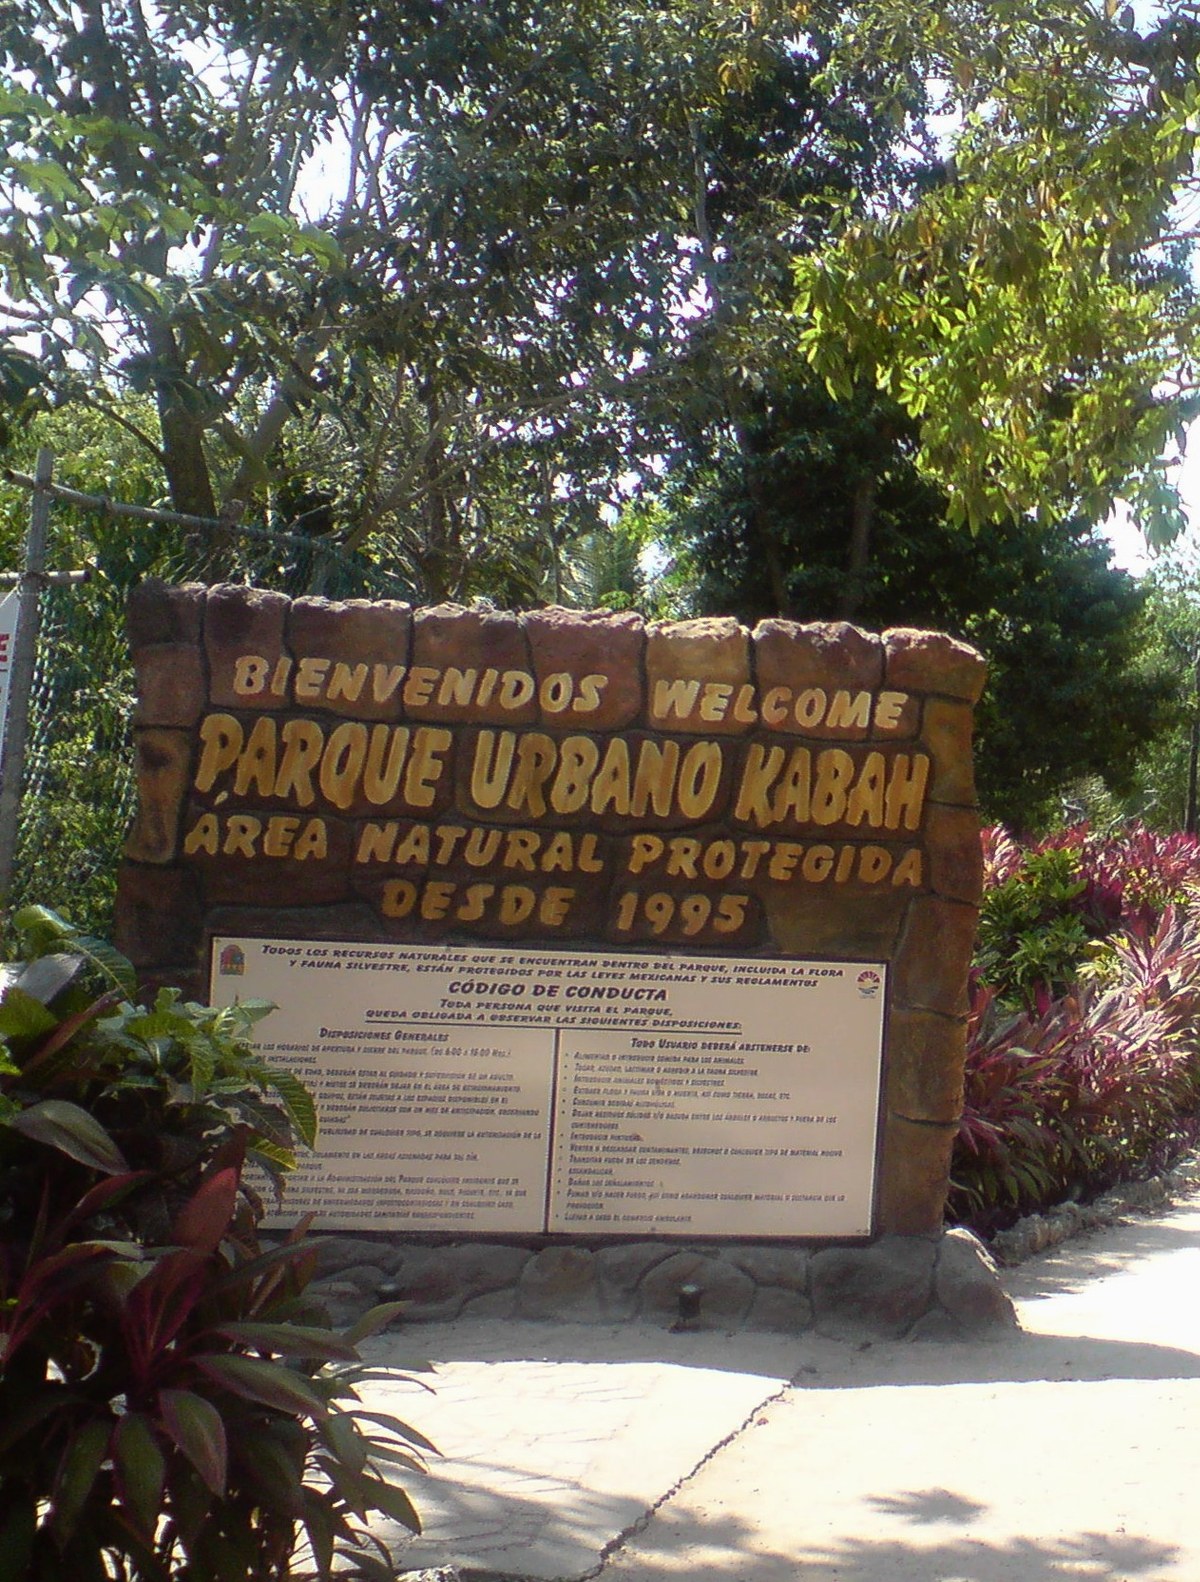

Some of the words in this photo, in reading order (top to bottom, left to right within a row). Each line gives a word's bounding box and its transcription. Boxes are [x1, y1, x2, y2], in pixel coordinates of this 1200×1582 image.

[233, 655, 608, 713] BIENVENIDOS
[653, 679, 908, 729] WELCOME
[195, 713, 451, 809] PARQUE
[472, 730, 722, 819] URBANO
[735, 744, 929, 830] KABAH
[185, 791, 327, 860] ÁREA
[356, 822, 603, 872] NATURAL
[628, 833, 922, 887] PROTEGIDA
[381, 878, 575, 926] DESDE
[617, 891, 748, 935] 1995
[261, 944, 303, 955] TODOS
[305, 948, 328, 956] LOS
[331, 949, 395, 959] RECURSOS
[398, 952, 468, 961] NATURALES
[470, 955, 496, 963] QUE
[518, 957, 598, 967] ENCUENTRAN
[600, 960, 649, 969] DENTRO
[652, 962, 676, 970] DEL
[677, 963, 732, 972] PARQUE,
[807, 968, 844, 976] FLORA
[300, 960, 342, 968] FAUNA
[345, 962, 411, 971] SILVESTRE,
[415, 964, 454, 972] ESTÁN
[457, 966, 533, 976] PROTEGIDOS
[536, 969, 562, 977] POR
[565, 970, 587, 978] LAS
[590, 971, 625, 979] LEYES
[628, 973, 696, 982] MEXICANAS
[734, 977, 818, 986] REGLAMENTOS
[447, 981, 526, 995] CÓDIGO
[531, 984, 559, 997] DE
[564, 986, 668, 1000] CONDUCTA
[365, 1009, 407, 1018] QUEDA
[411, 1011, 473, 1020] OBLIGADA
[476, 1013, 485, 1021] A
[489, 1014, 552, 1023] OBSERVAR
[554, 1016, 576, 1024] LAS
[579, 1017, 648, 1026] SIGUIENTES
[651, 1019, 742, 1029] DISPOSICIONES:
[439, 998, 473, 1008] TODA
[475, 1002, 532, 1010] PERSONA
[536, 1004, 561, 1012] QUE
[564, 1005, 601, 1013] VISITA
[630, 1037, 656, 1048] TODO
[657, 1039, 699, 1049] USUARIO
[699, 1042, 736, 1050] DEBERÁ
[738, 1043, 794, 1052] ABSTENERSE
